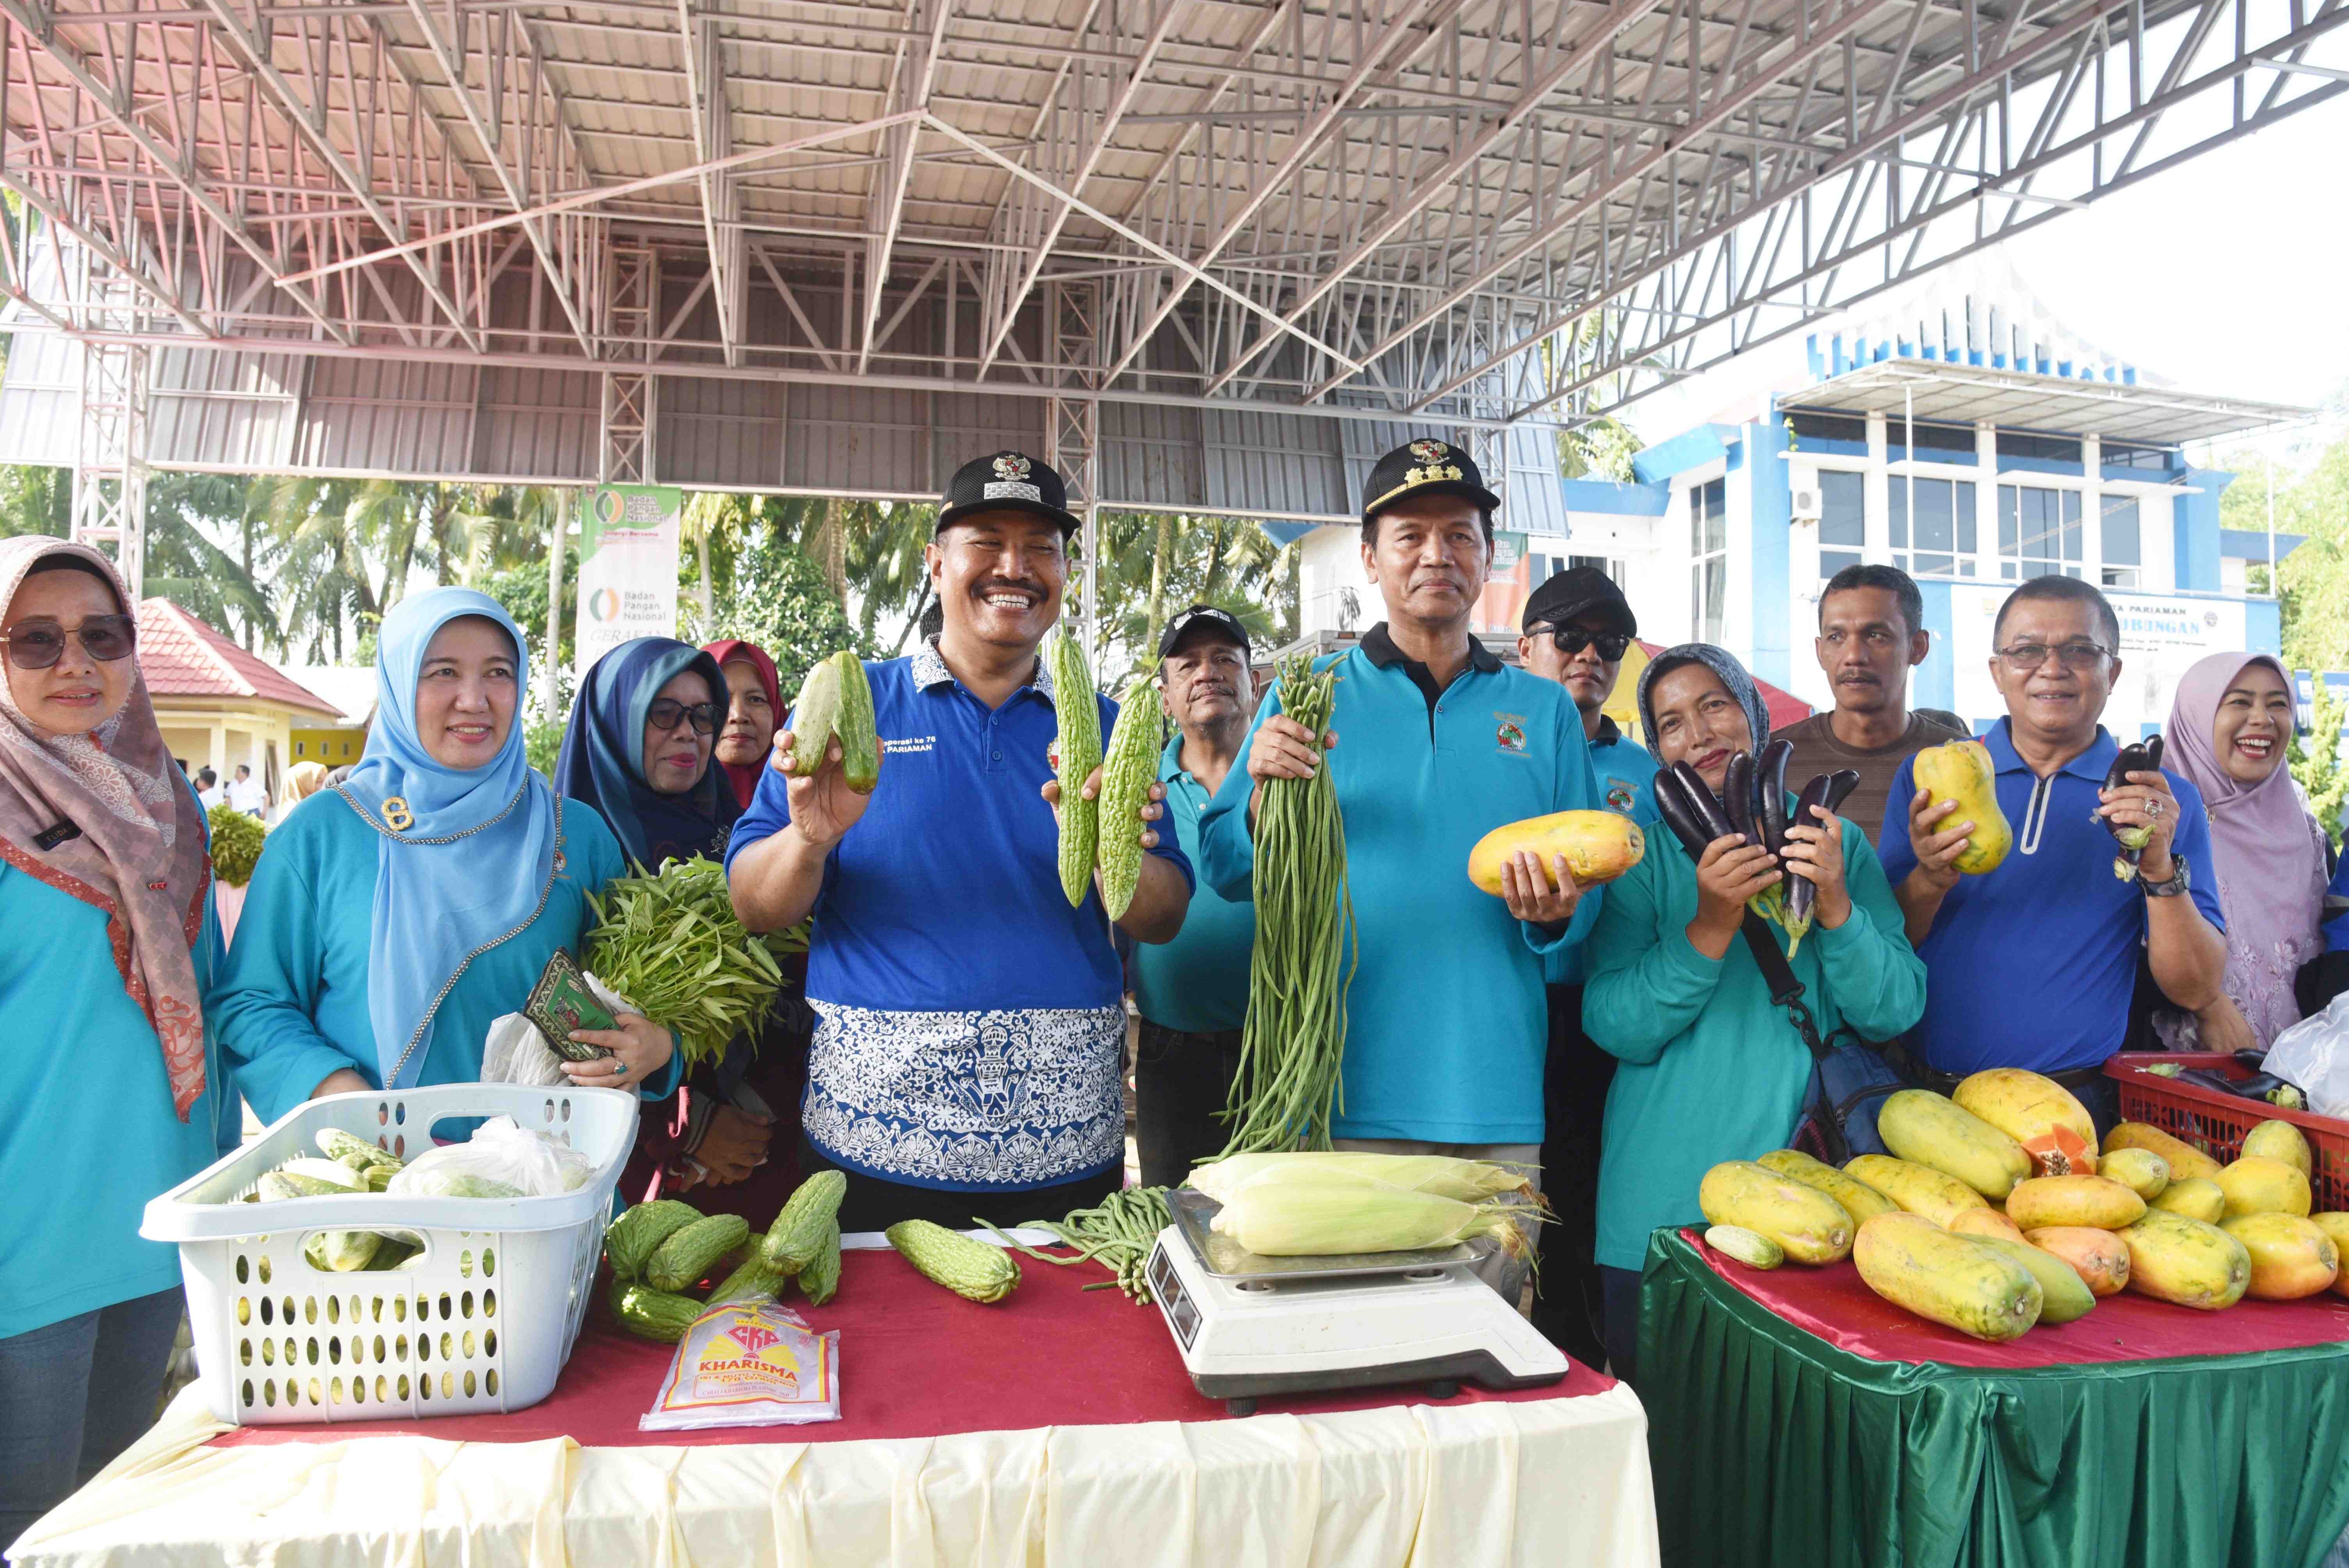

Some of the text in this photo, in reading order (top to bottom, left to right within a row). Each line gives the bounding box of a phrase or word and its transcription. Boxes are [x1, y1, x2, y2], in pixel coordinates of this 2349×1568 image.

[628, 494, 656, 503] Badan
[627, 504, 661, 513] Pangan
[627, 513, 668, 522] Nasional
[625, 592, 655, 600] Badan
[624, 602, 660, 610] Pangan
[2129, 606, 2186, 615] PARIAMAN
[624, 612, 666, 620] Nasional
[884, 738, 913, 746] operasi
[887, 744, 932, 753] PARIAMAN
[699, 1360, 797, 1381] KHARISMA
